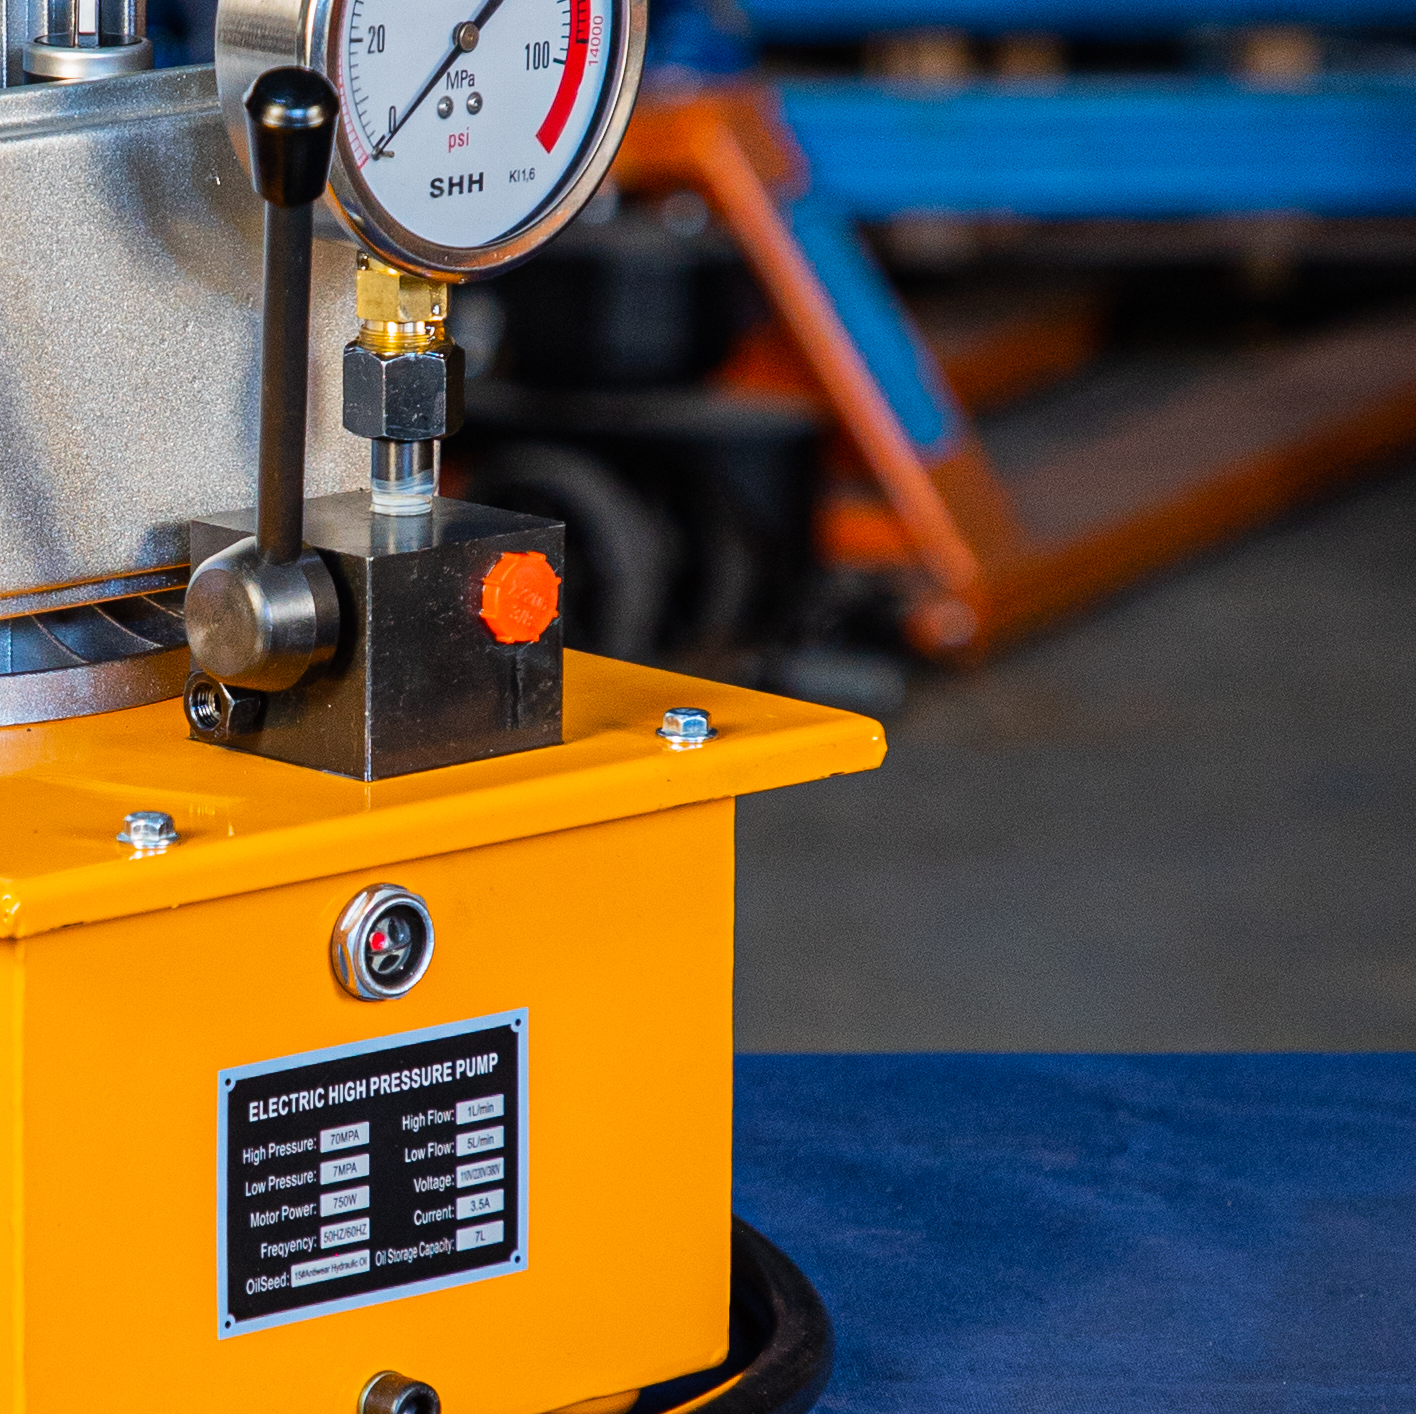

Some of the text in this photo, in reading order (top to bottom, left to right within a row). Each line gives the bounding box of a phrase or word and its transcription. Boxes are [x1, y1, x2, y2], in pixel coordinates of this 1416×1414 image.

[367, 24, 385, 54] 20
[588, 15, 604, 66] 14000
[525, 41, 550, 71] 100
[446, 69, 475, 90] MPa
[388, 105, 397, 134] 0
[448, 127, 470, 153] psi
[429, 172, 484, 198] SHH
[249, 1052, 498, 1122] ELECTRIC HIGH PRESSURE PUMP
[402, 1102, 494, 1133] High Flow: 1L/min
[242, 1129, 360, 1165] High Pressure: 70MPA
[404, 1133, 494, 1163] Low Flow: 5L/min
[245, 1162, 358, 1197] Low Pressure: 7MPA
[413, 1174, 454, 1193] Voltage:
[250, 1193, 358, 1228] Motor Power: 750W
[413, 1197, 491, 1226] Current: 3.5A
[324, 1223, 368, 1244] 50HZ/60HZ
[375, 1230, 486, 1266] Oil Storage Capacity: 7L
[245, 1271, 290, 1295] OilSeed:
